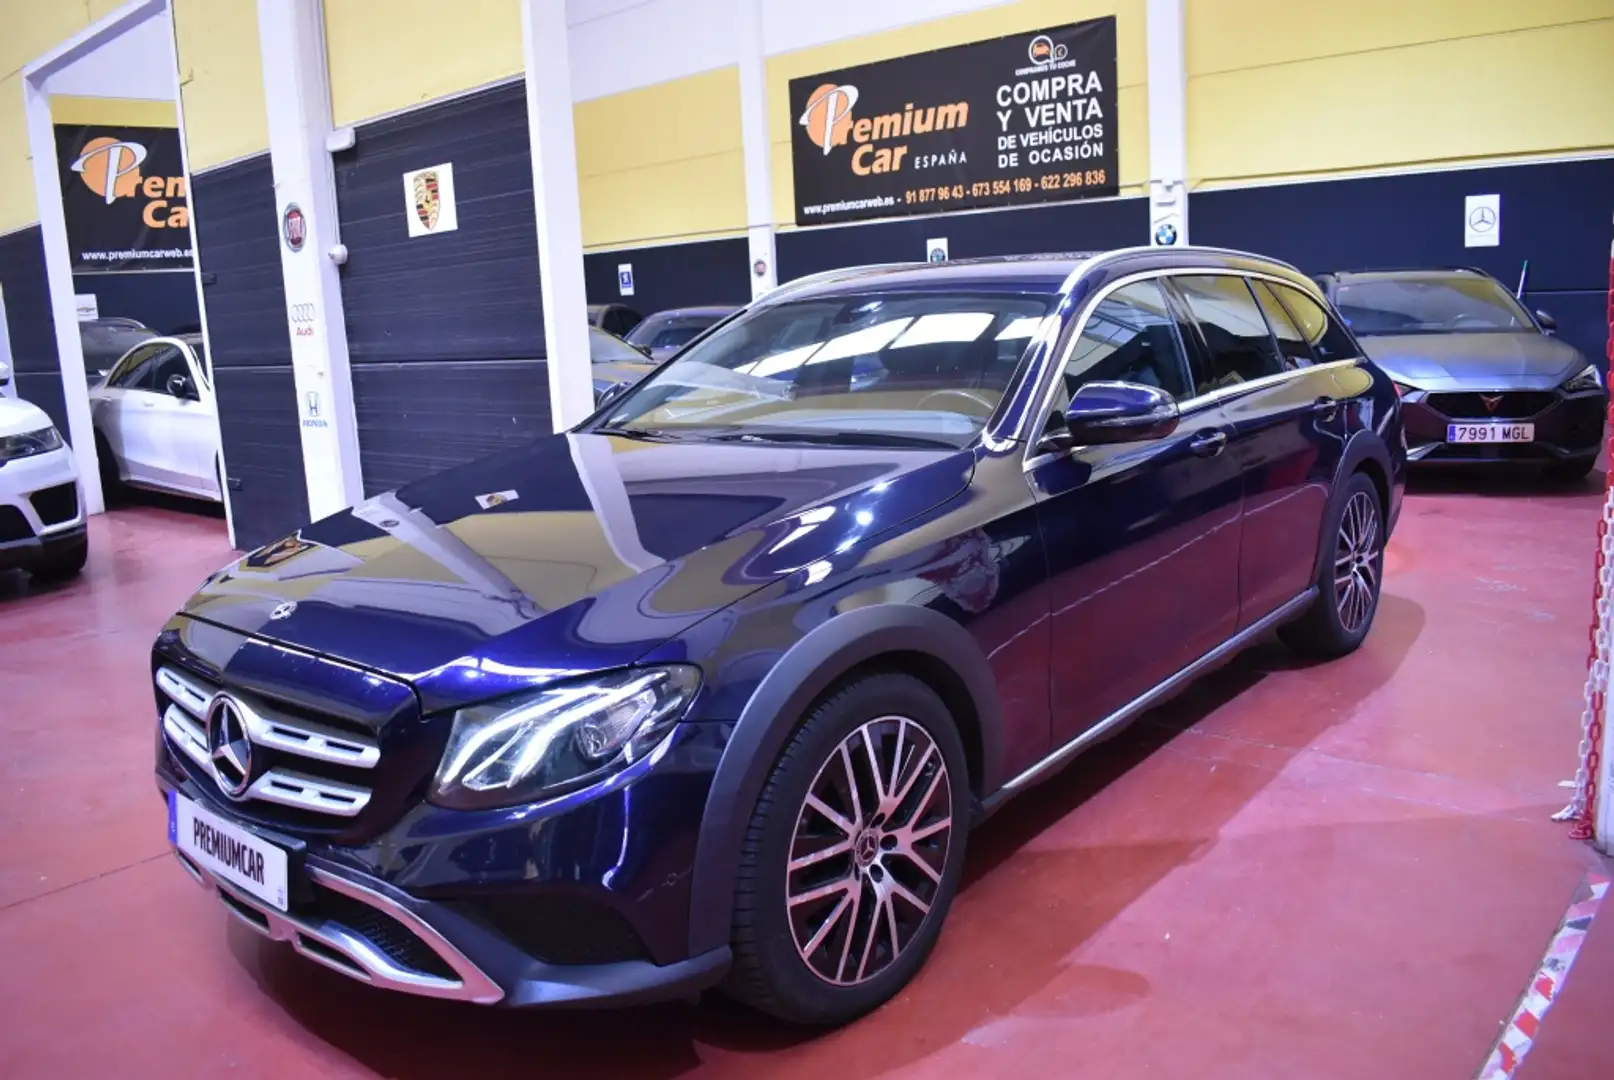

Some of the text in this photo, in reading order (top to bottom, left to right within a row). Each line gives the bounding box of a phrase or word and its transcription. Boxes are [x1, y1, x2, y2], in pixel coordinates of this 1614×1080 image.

[996, 71, 1103, 107] COMPRA
[799, 84, 969, 157] Premium
[996, 97, 1103, 132] Y VENTA
[997, 123, 1103, 151] DE VEHÍCULOS
[998, 140, 1103, 168] DE OCASIÓN
[851, 143, 968, 176] Car ESPAÑA
[905, 190, 916, 205] 91
[919, 187, 936, 203] 877
[938, 186, 950, 200] 96
[952, 184, 964, 199] 43
[972, 181, 990, 197] 673
[993, 180, 1010, 195] 554
[1014, 177, 1032, 192] 169
[1041, 174, 1061, 190] 622
[1063, 172, 1082, 187] 296
[1085, 169, 1106, 185] 836
[1458, 426, 1530, 441] 7991 MGL
[193, 816, 265, 886] PREMIUMCAR
